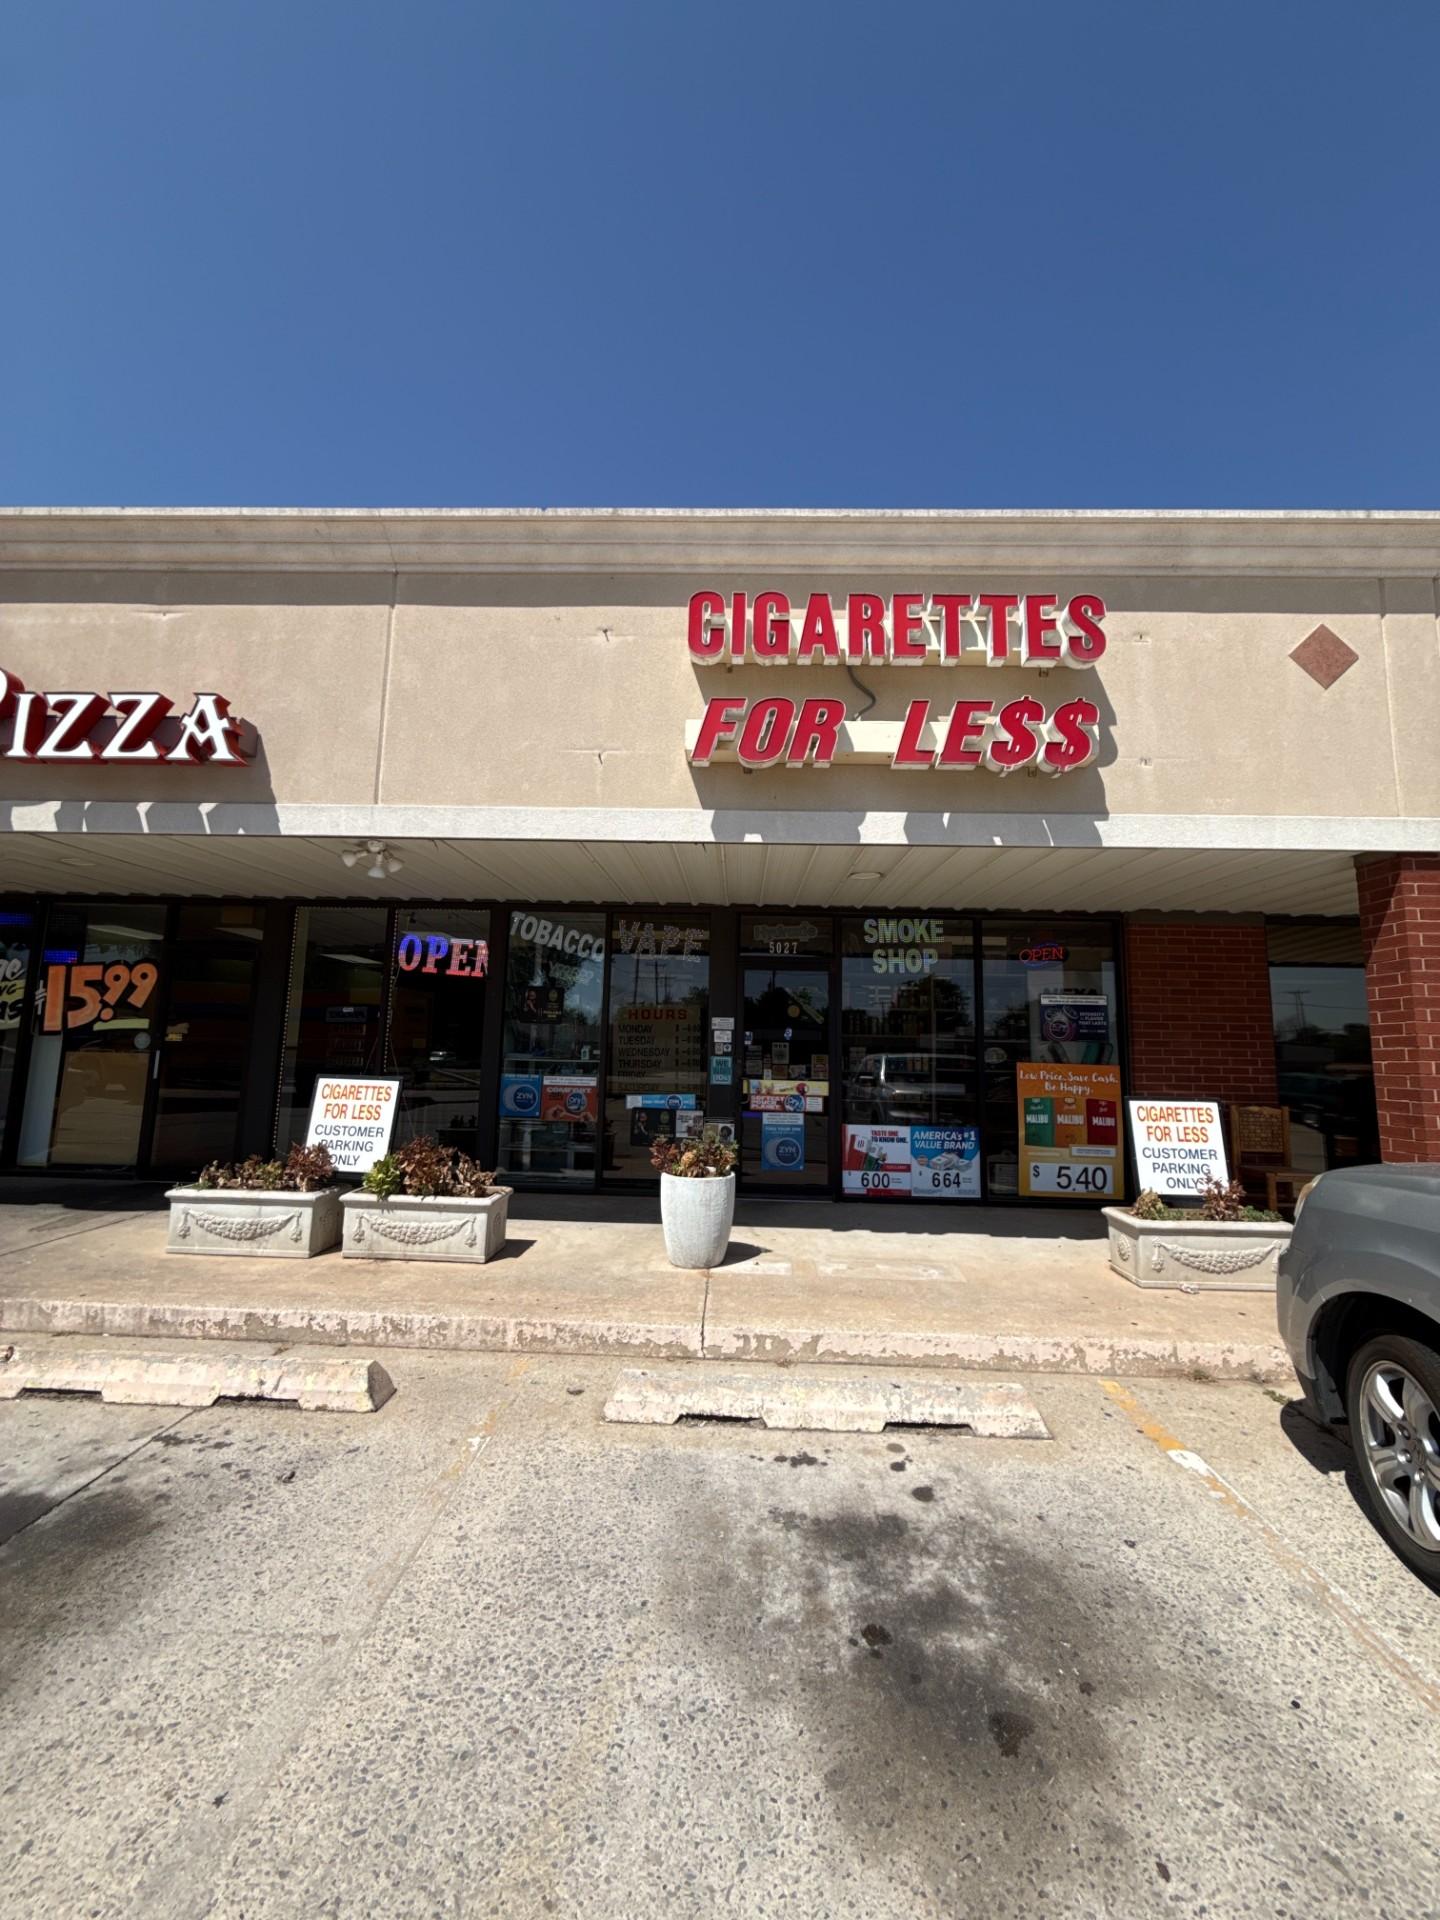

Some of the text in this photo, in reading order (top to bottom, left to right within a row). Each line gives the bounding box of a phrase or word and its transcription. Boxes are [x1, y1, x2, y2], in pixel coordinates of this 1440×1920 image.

[687, 590, 1107, 662] CIGARETTES
[0, 669, 239, 760] IZZA
[690, 695, 1100, 774] FOR LE$$
[510, 911, 605, 962] TOBACCO
[863, 918, 945, 944] SMOKE
[769, 942, 798, 954] 5027
[1019, 948, 1064, 962] OPEN
[872, 949, 938, 974] SHOP
[628, 1009, 688, 1020] HOURS
[618, 1024, 653, 1034] MONDAY
[619, 1036, 656, 1046] TUESDAY
[618, 1048, 671, 1057] WEDNESDAY
[1020, 1070, 1038, 1081] Low
[1068, 1071, 1089, 1082] Save
[1091, 1072, 1119, 1084] Cash.
[321, 1083, 392, 1102] CIGARETTES
[1045, 1082, 1094, 1095] Be Happy.
[323, 1103, 382, 1121] FOR LESS
[1137, 1105, 1215, 1124] CIGARETTES
[314, 1124, 385, 1138] CUSTOMER
[913, 1130, 977, 1141] AMERICA's #1
[1146, 1125, 1209, 1143] FOR LESS
[914, 1140, 975, 1150] VALUE BRAND
[1142, 1147, 1218, 1161] CUSTOMER
[1152, 1162, 1212, 1176] PARKING
[861, 1172, 891, 1189] 600
[932, 1171, 961, 1189] 664
[1032, 1164, 1108, 1191] $ 5.40
